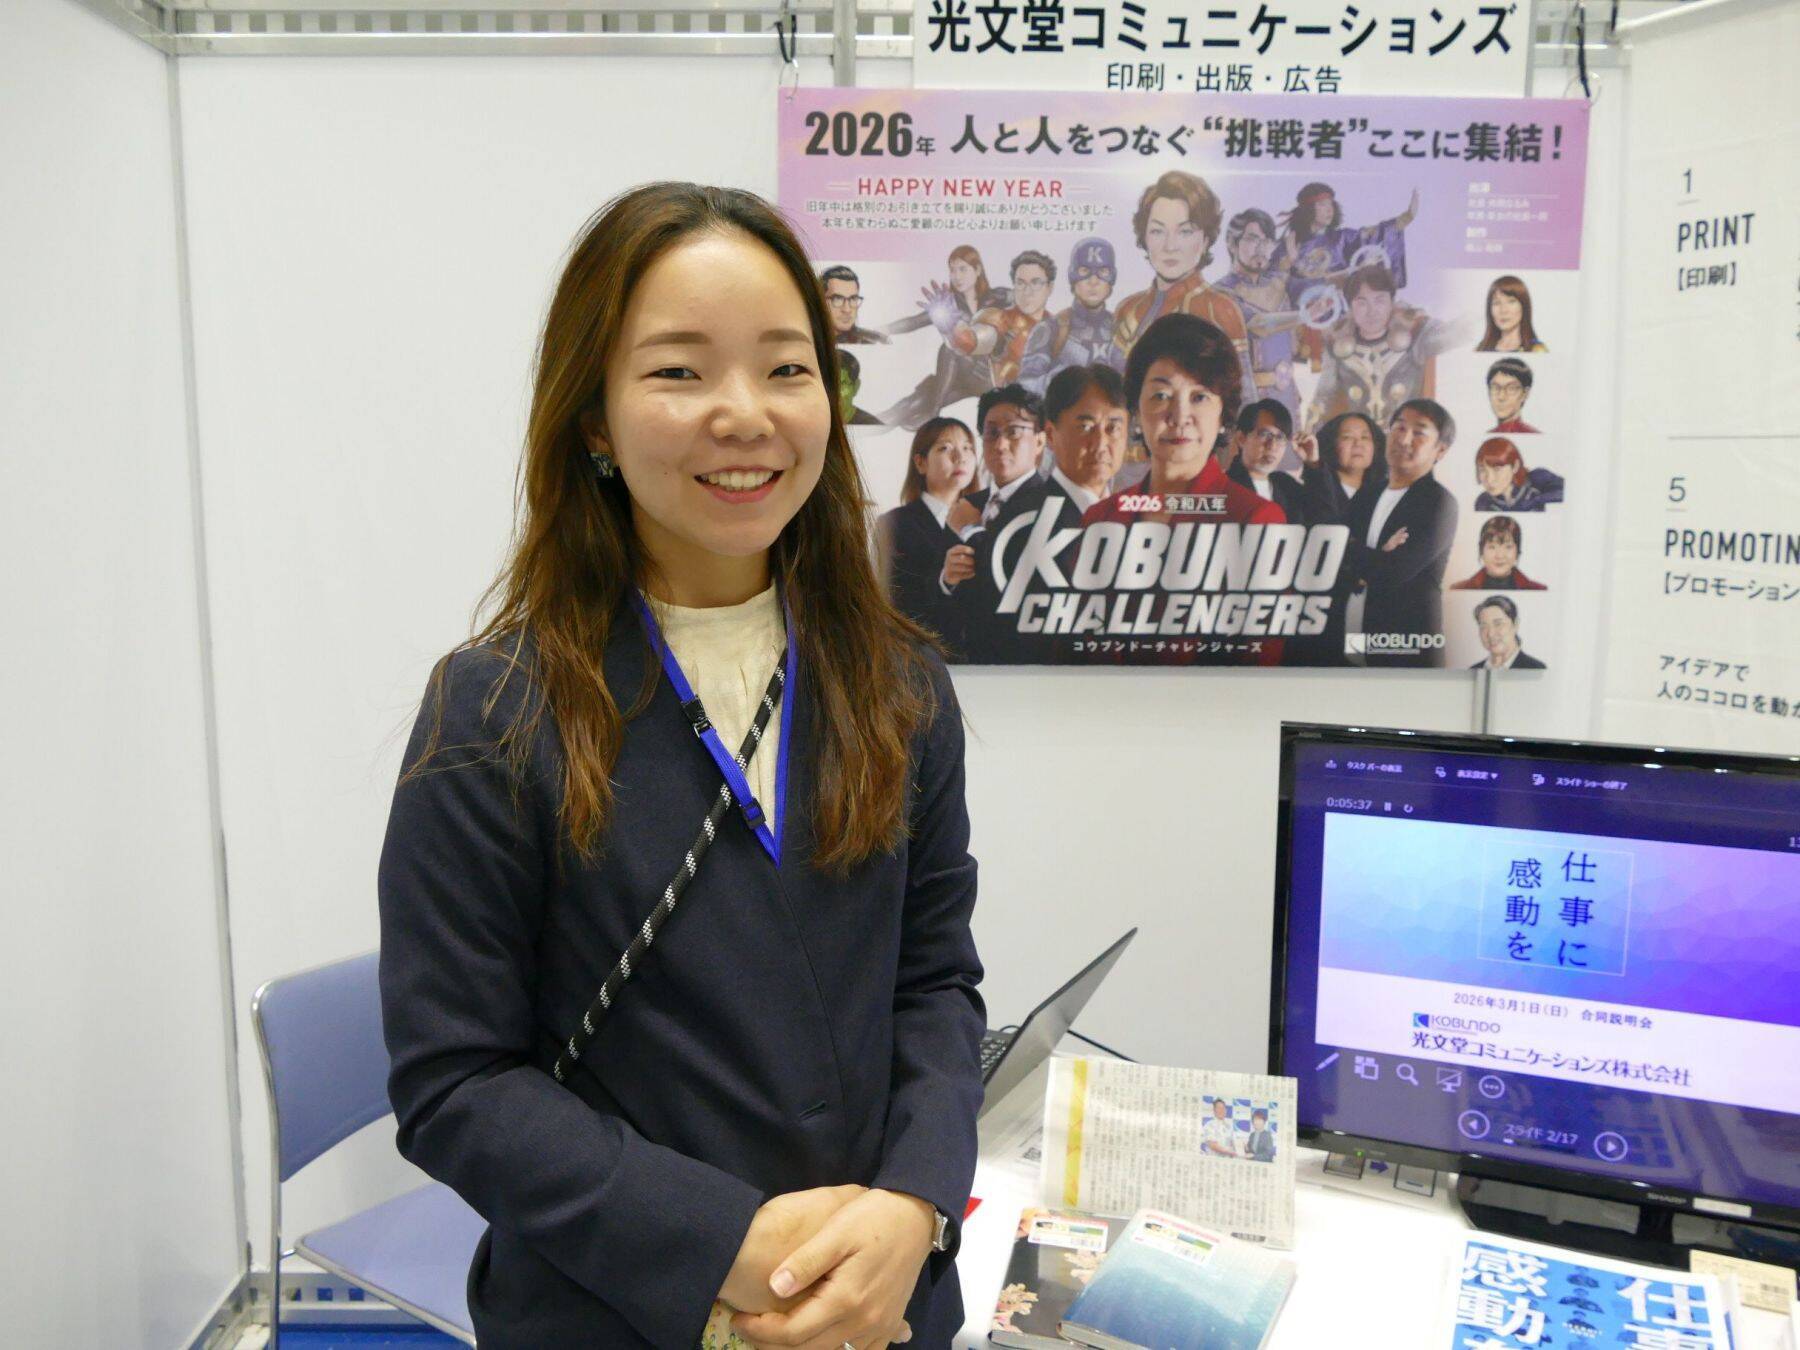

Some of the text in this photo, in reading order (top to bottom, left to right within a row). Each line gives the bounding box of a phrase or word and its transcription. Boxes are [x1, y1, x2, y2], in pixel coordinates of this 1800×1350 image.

[928, 0, 1517, 56] 光文堂コミュニケーションズ
[1107, 62, 1342, 93] 印刷・出版・広告
[805, 111, 936, 157] 2026年
[858, 178, 1063, 198] HAPPY NEW YEAR
[1683, 168, 1692, 193] 1
[1678, 213, 1755, 253] PRINT
[1087, 246, 1103, 263] K
[1118, 495, 1226, 512] 2026 令和八年
[1668, 477, 1686, 502] 5
[992, 496, 1350, 613] KOBUNDO
[1665, 529, 1800, 565] PROMOTIN
[1017, 594, 1332, 636] CHALLENGERS
[1660, 655, 1750, 682] アイデアで
[1326, 797, 1372, 810] 0:05:37
[1504, 858, 1542, 961] 感動を
[1558, 851, 1597, 967] 仕事に
[1581, 1008, 1653, 1030] 合同説明会
[1412, 1031, 1692, 1087] 光文堂コミュニケーションズ株式会社
[1547, 1130, 1578, 1144] 2/17
[1456, 1244, 1549, 1350] 感動
